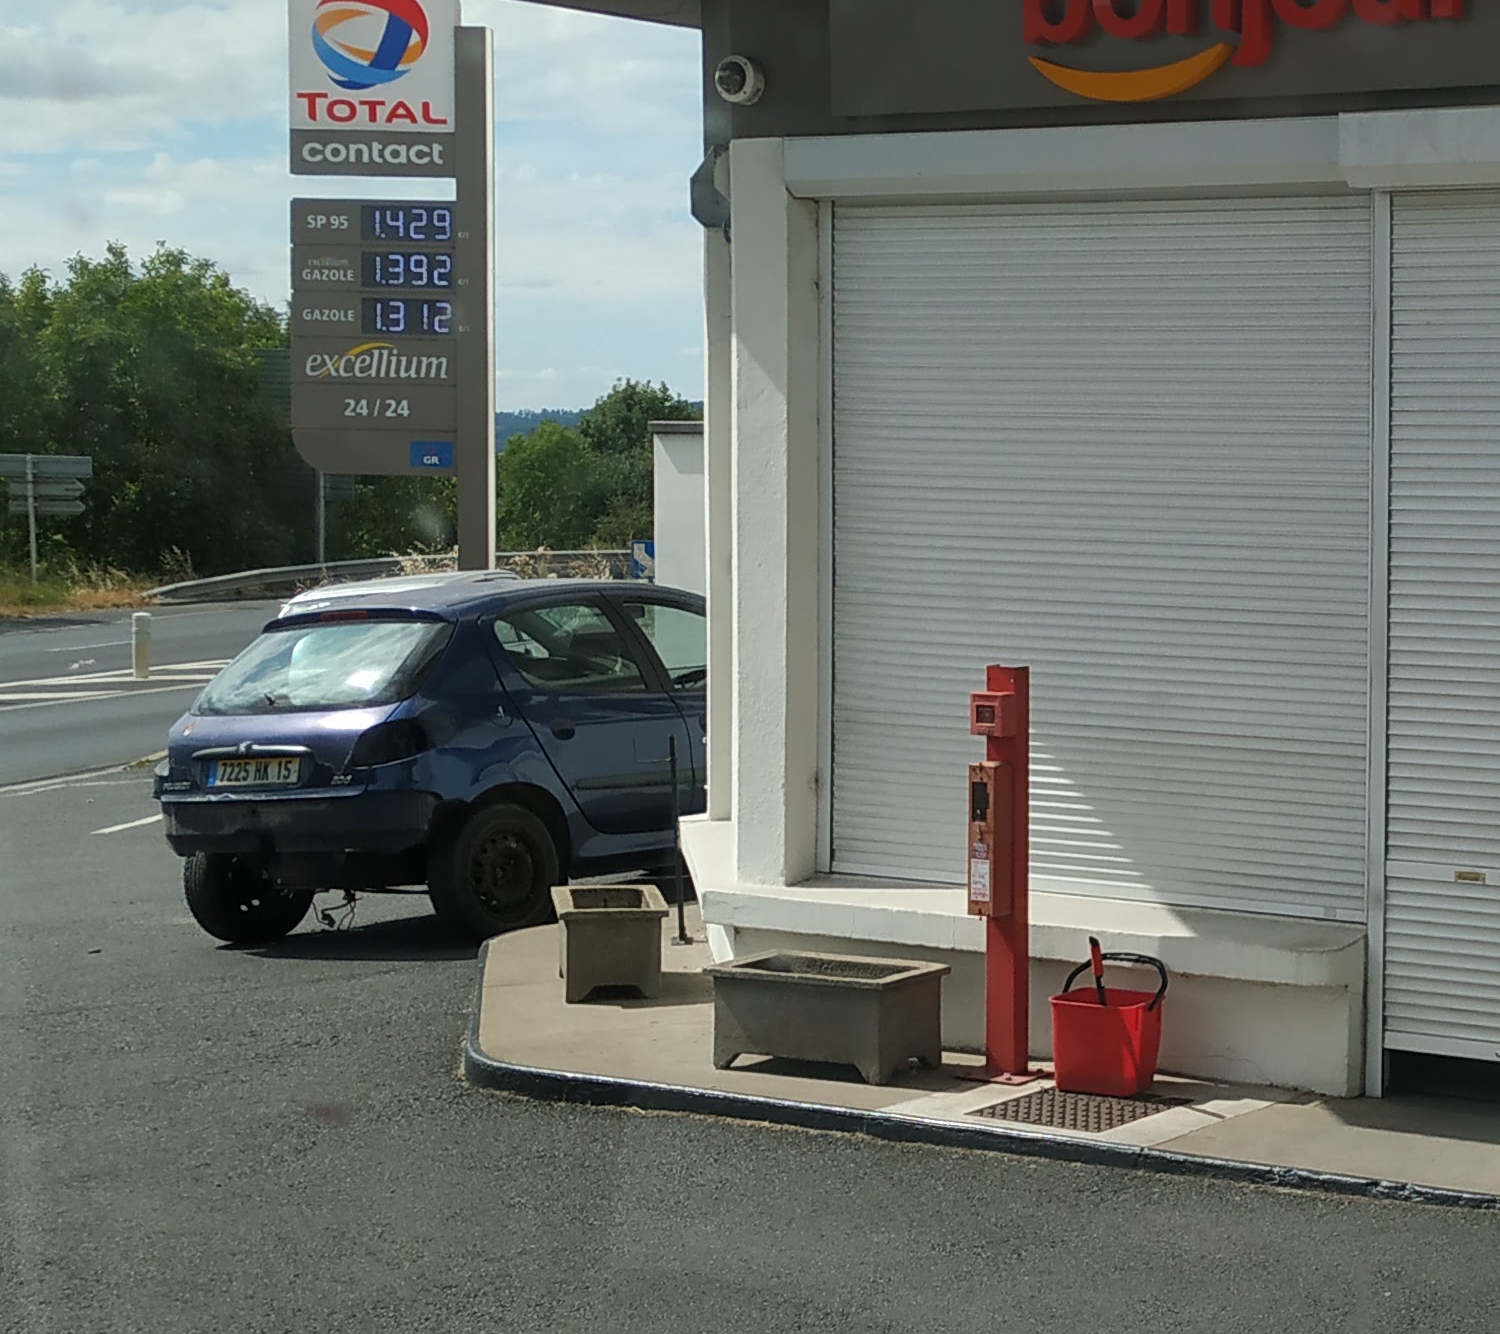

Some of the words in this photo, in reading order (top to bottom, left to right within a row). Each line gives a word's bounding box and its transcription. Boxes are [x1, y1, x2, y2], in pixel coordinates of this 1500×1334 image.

[296, 92, 448, 125] TOTAL
[302, 140, 443, 165] contact
[307, 215, 326, 229] SP
[330, 215, 348, 229] 95
[375, 209, 450, 240] 1.429
[302, 269, 354, 281] GAZOLE
[375, 254, 450, 285] 1.392
[302, 309, 355, 322] GAZOLE
[376, 301, 451, 333] 1.312
[305, 348, 448, 379] excellium
[423, 455, 440, 465] GR
[220, 762, 250, 782] 7225
[254, 760, 270, 781] HK
[276, 759, 293, 780] 15
